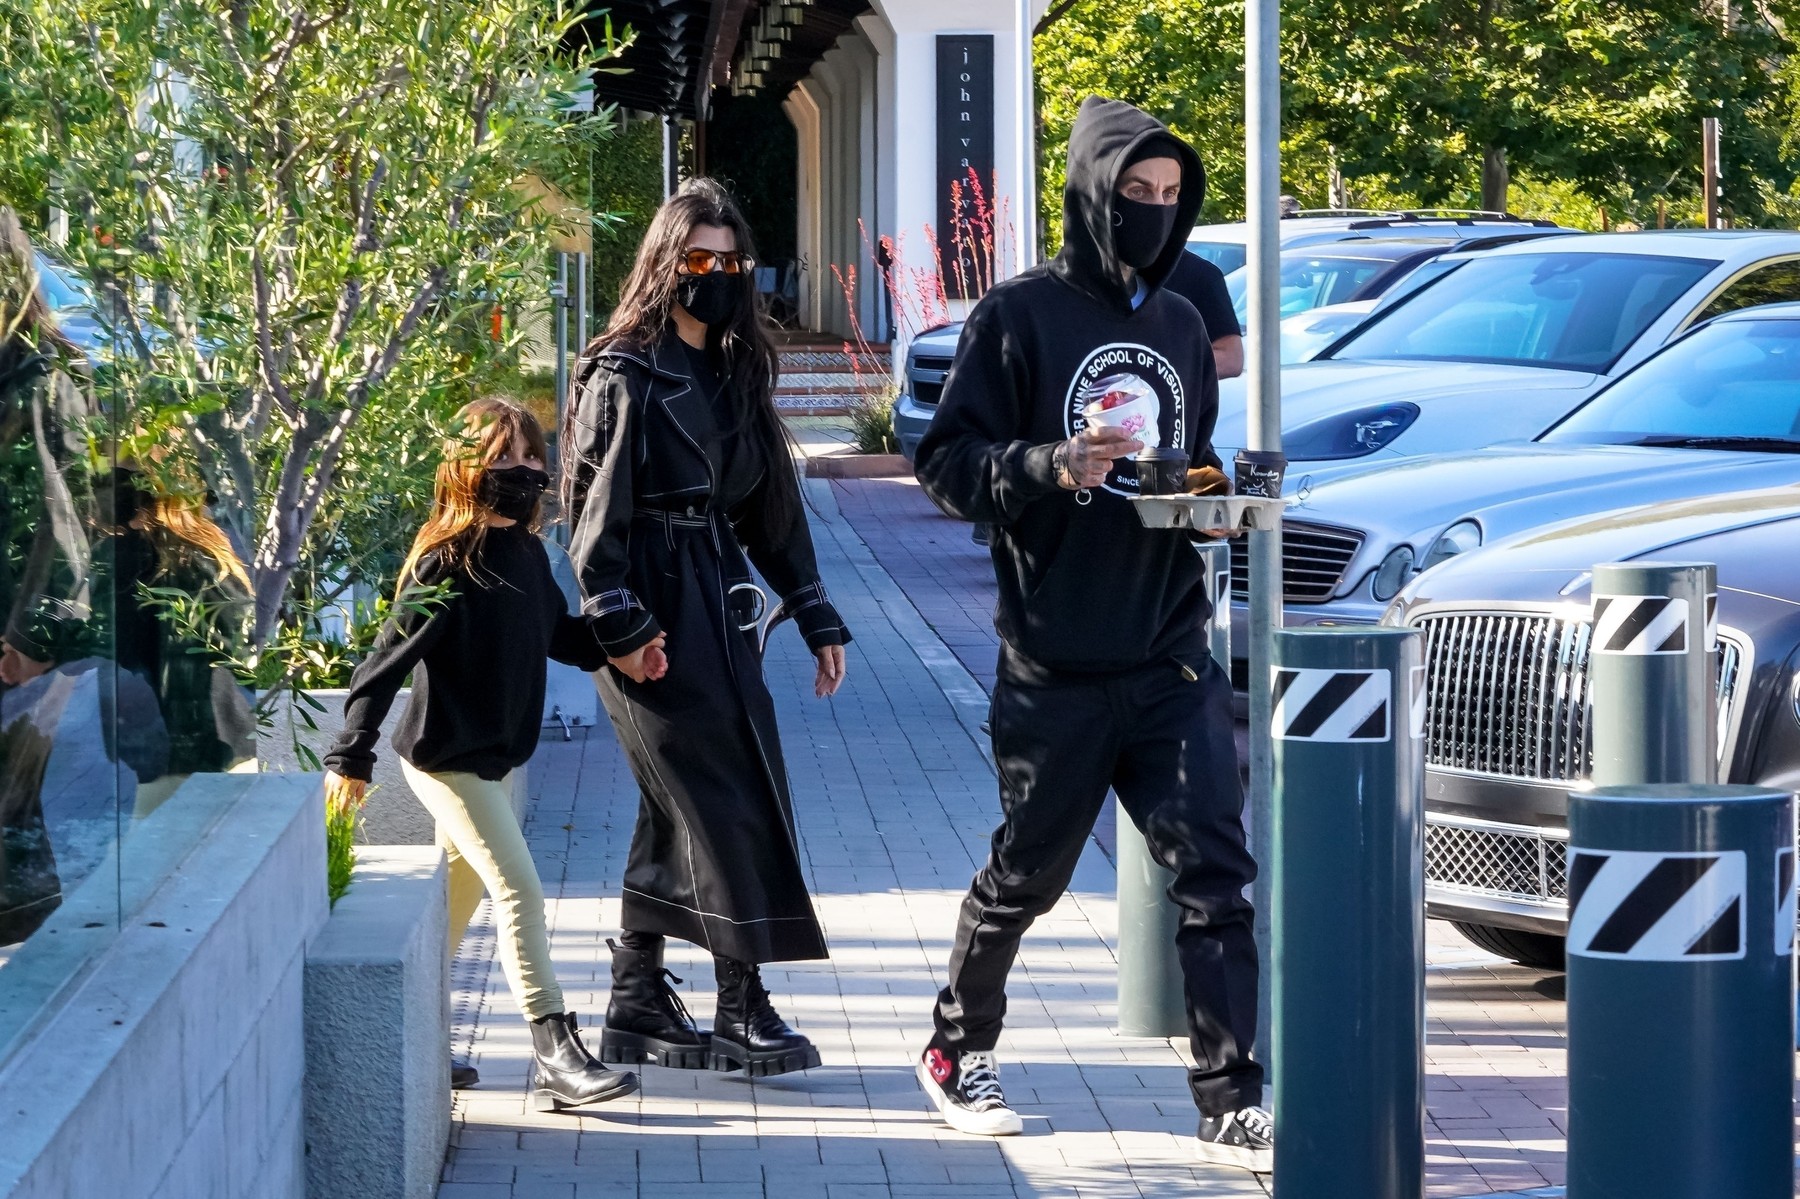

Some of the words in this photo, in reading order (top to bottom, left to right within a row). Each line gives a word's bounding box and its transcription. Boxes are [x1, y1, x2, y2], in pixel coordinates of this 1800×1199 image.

[959, 47, 971, 122] john
[1087, 349, 1133, 378] SCHOOL
[1137, 352, 1154, 368] OF
[1157, 362, 1182, 414] VISUAL
[1116, 475, 1140, 487] SINCE
